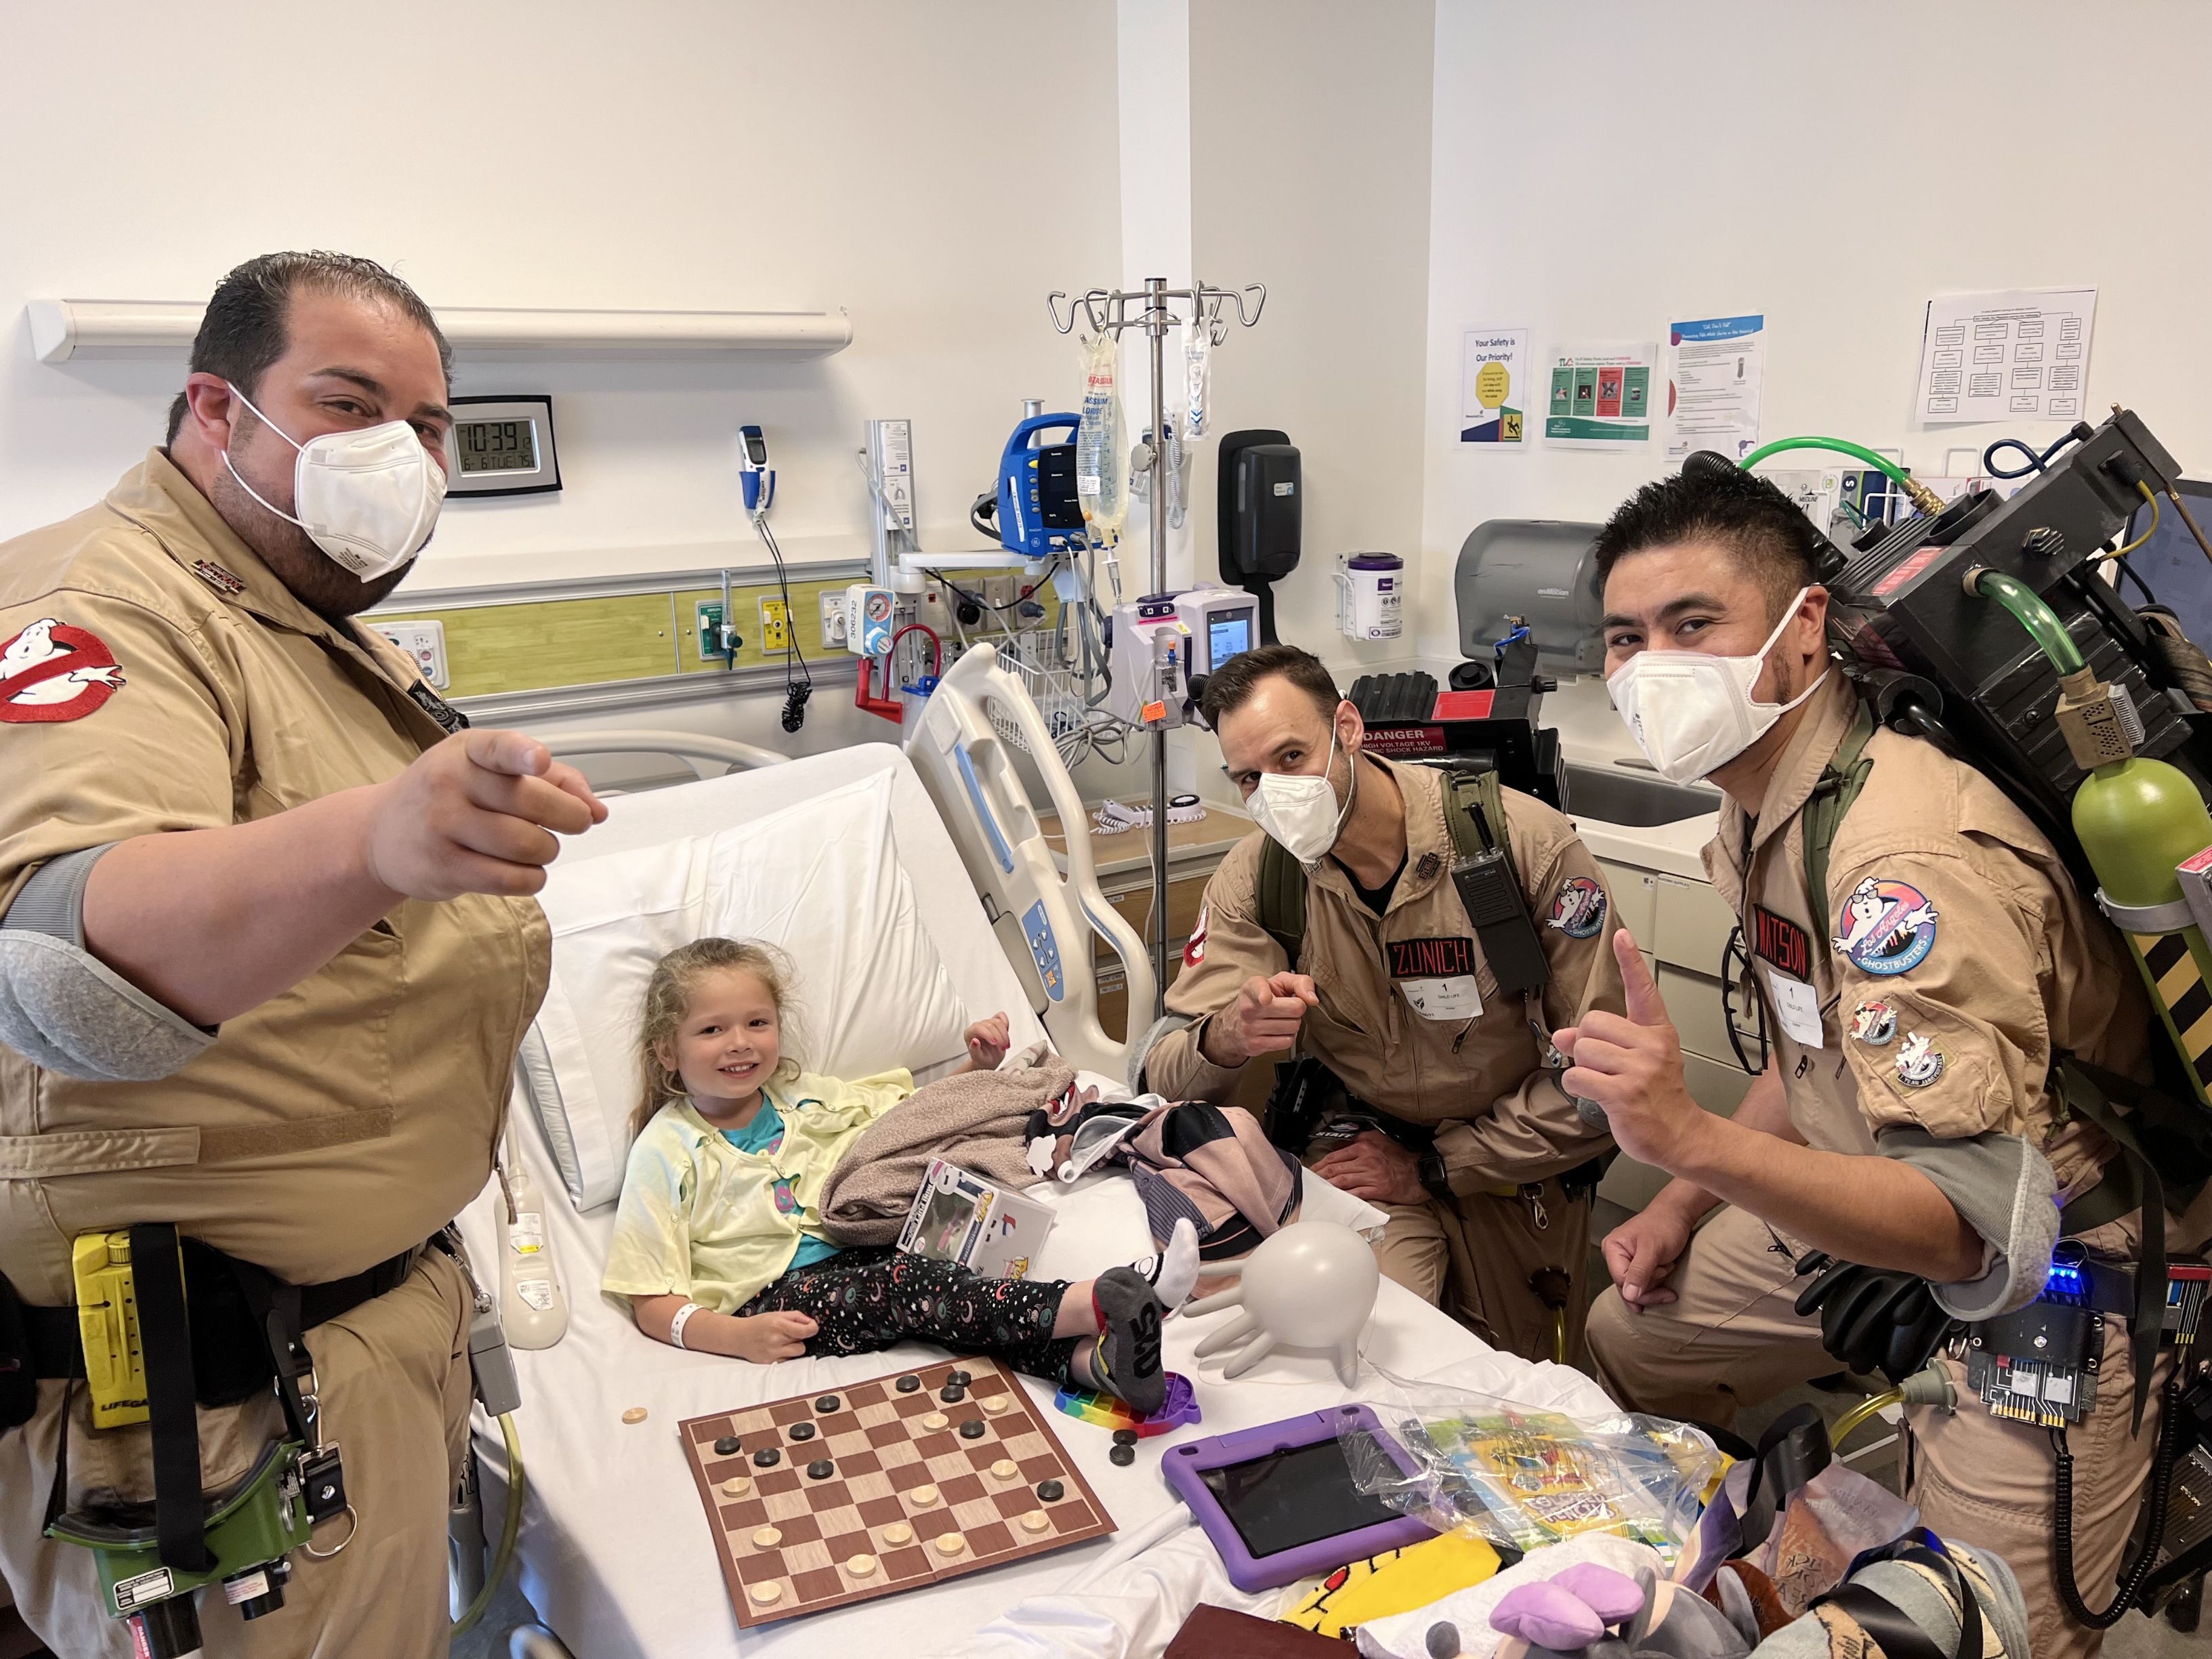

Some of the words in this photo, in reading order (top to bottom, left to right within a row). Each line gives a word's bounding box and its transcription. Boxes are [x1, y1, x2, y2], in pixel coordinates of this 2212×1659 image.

[1475, 339, 1489, 348] Your
[1490, 338, 1508, 347] Safety
[1476, 354, 1487, 362] Our
[1488, 353, 1512, 362] Priority!
[1088, 375, 1112, 386] OTASSIU
[1084, 396, 1108, 405] ASSIUM
[1083, 406, 1103, 415] LORIDE
[468, 423, 517, 452] 10:39
[491, 456, 512, 469] TUE
[1363, 730, 1425, 741] DANGER
[1572, 909, 1605, 936] GHOSTBUSTERS
[1860, 934, 1877, 956] Los
[1877, 902, 1910, 938] Angeles
[1759, 910, 1806, 978] WATSON
[1393, 940, 1469, 975] ZUNICH
[1861, 939, 1927, 970] GHOSTBUSTERS
[1442, 983, 1447, 992] 1
[101, 1398, 149, 1411] LIFEGA
[138, 1626, 150, 1658] DANGER
